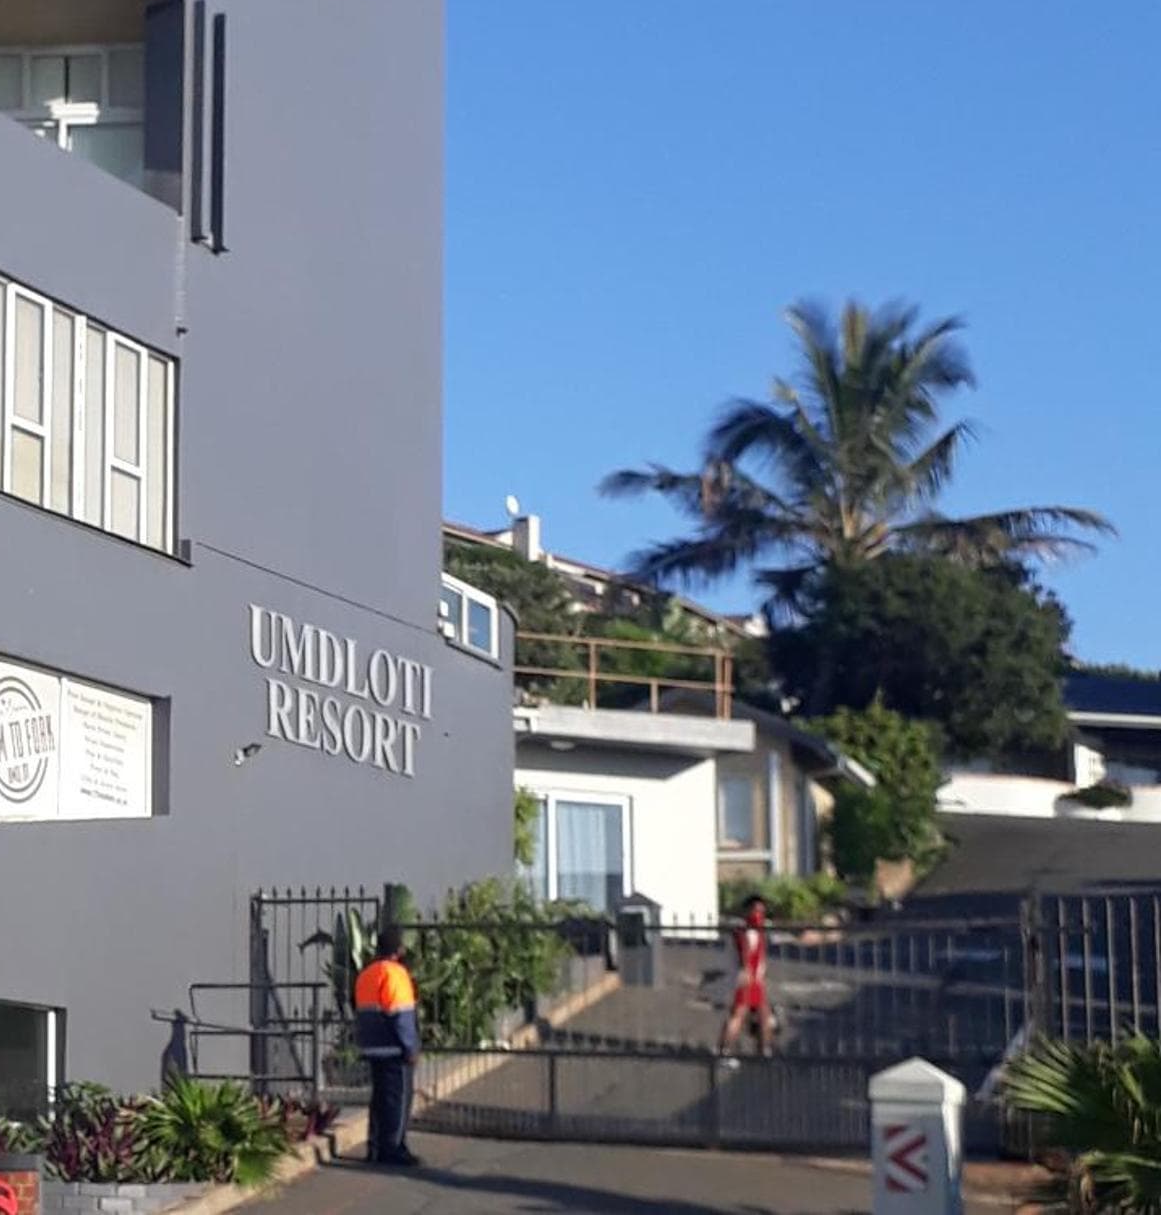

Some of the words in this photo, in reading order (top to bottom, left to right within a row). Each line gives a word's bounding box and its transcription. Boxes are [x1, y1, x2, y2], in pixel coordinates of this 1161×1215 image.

[248, 602, 434, 720] UMDLOTI
[8, 720, 24, 758] TO
[25, 715, 55, 756] FORK
[266, 678, 421, 778] RESORT
